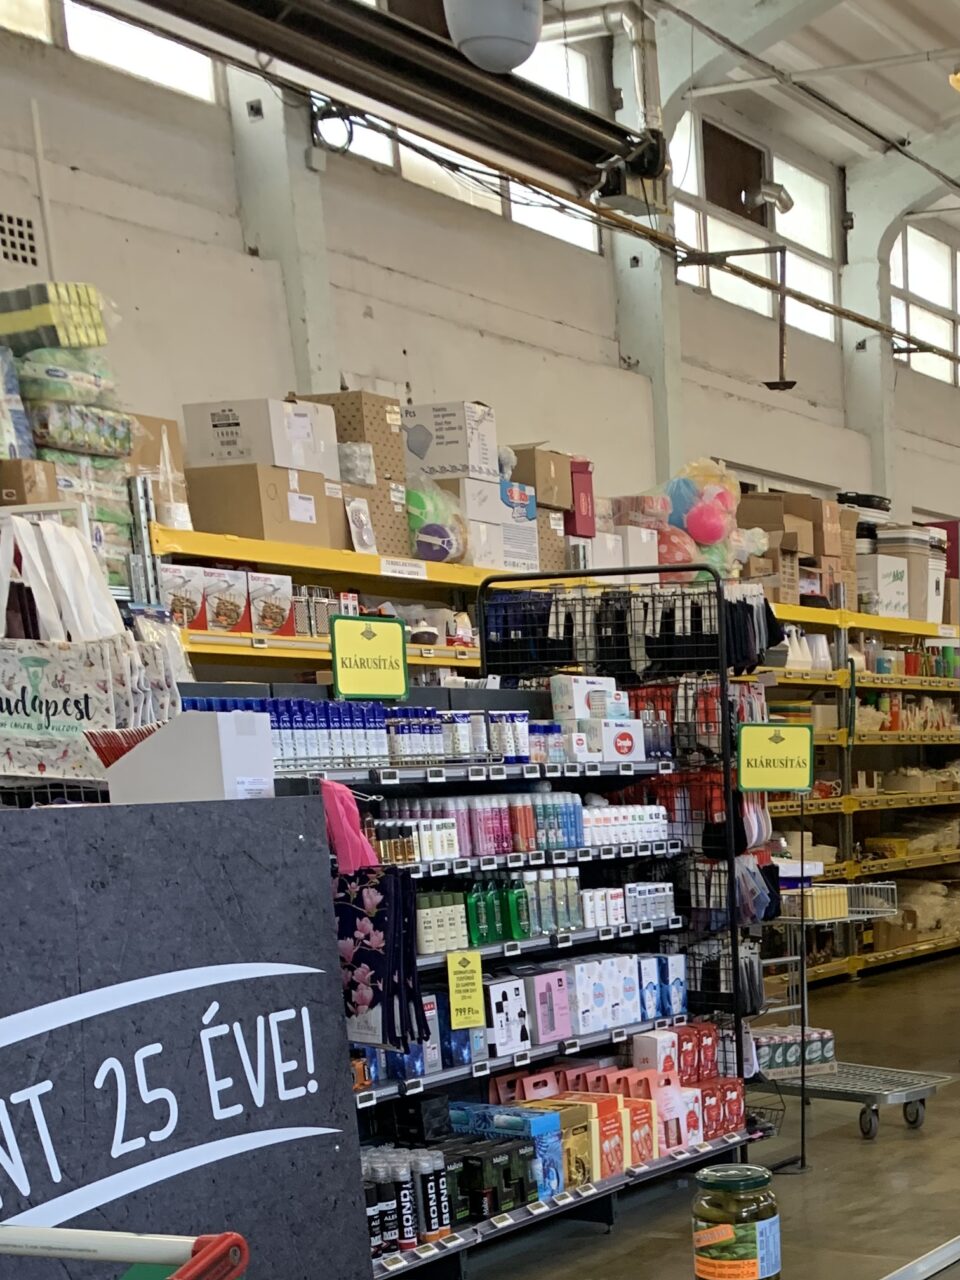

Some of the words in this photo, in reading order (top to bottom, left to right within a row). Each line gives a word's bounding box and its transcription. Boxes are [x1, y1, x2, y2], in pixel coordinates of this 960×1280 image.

[340, 656, 400, 673] KIÁRUSÍTÁS
[0, 686, 96, 728] udapest
[745, 755, 807, 770] KIÁRUSÍTÁS
[94, 1042, 179, 1158] 25
[200, 1000, 319, 1120] ÉVE!
[400, 1190, 414, 1239] BOND
[427, 1181, 439, 1230] BOND
[439, 1175, 450, 1225] BOND
